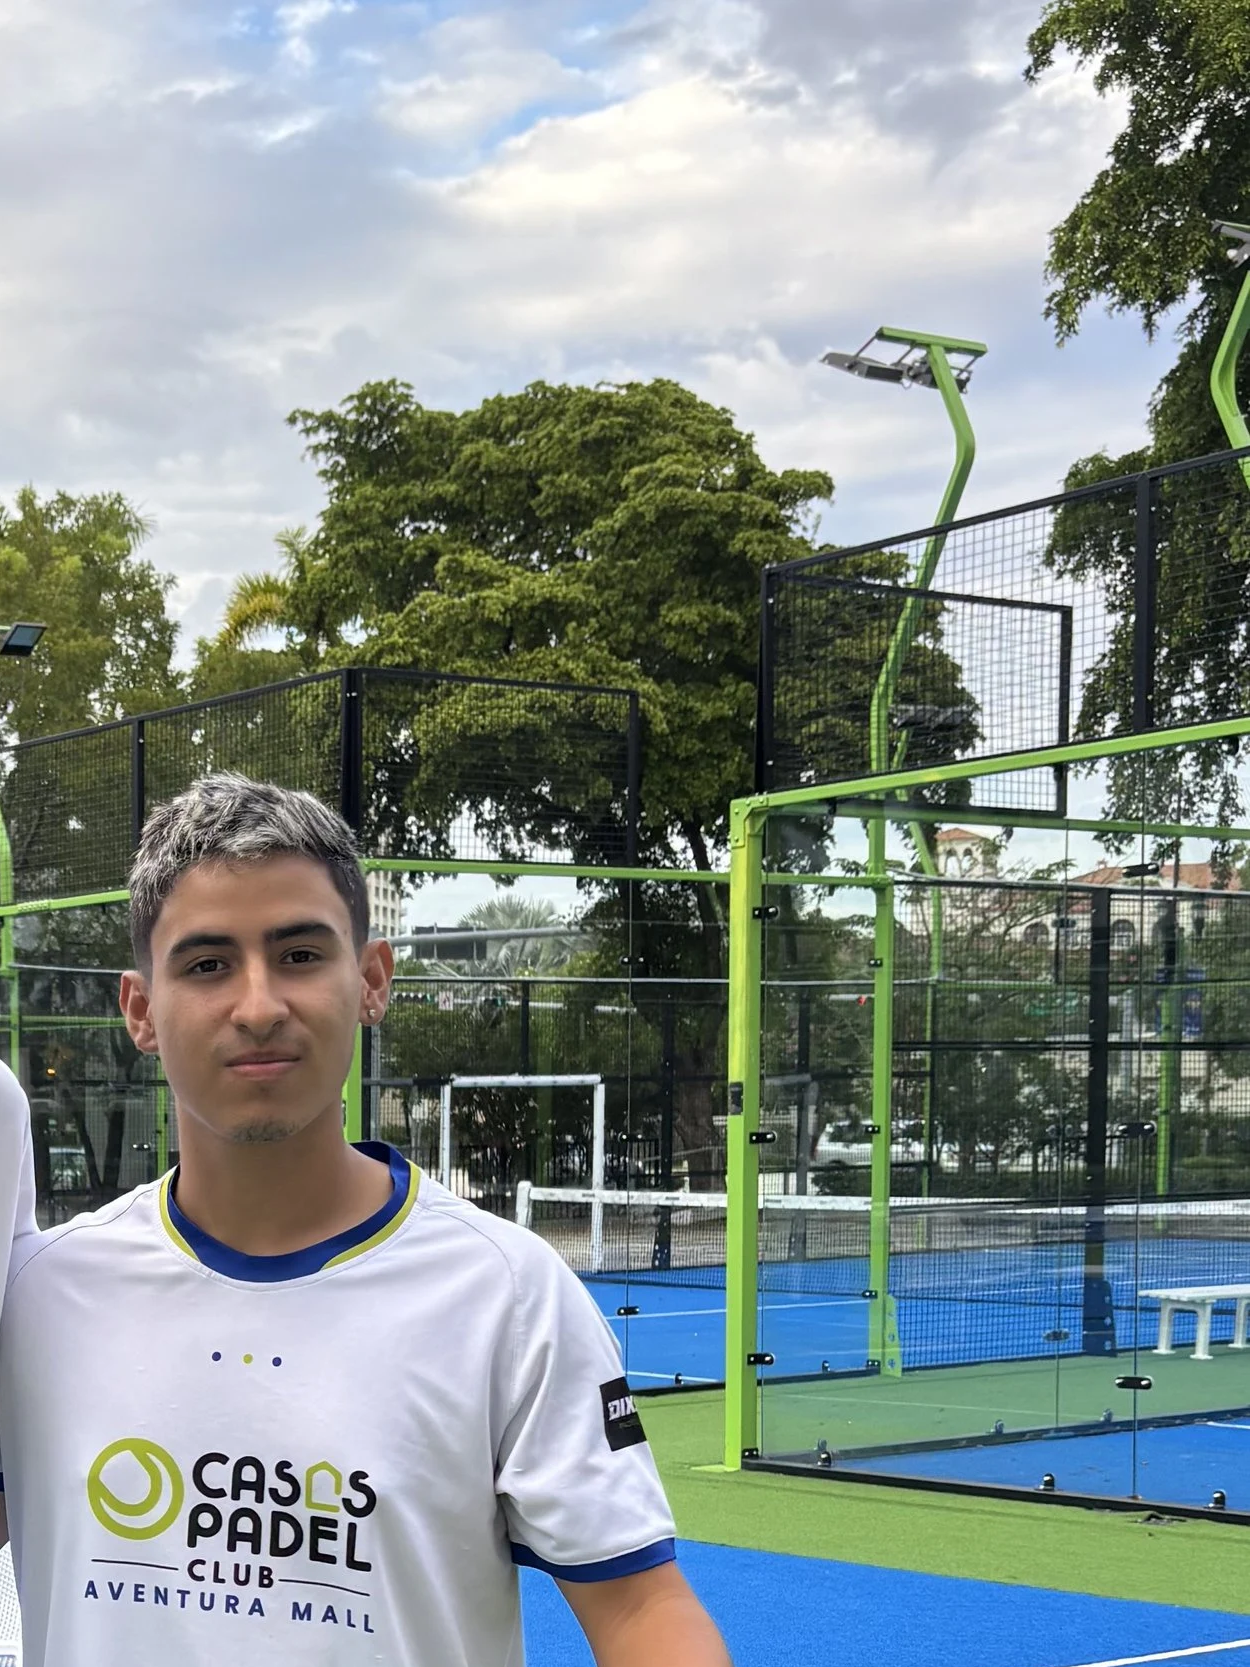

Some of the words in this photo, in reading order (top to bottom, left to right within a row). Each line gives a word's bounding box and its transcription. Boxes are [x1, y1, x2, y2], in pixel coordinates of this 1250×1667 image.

[187, 1502, 372, 1573] PADEL
[187, 1558, 275, 1589] CLUB
[84, 1579, 266, 1617] AVENTURA
[291, 1601, 375, 1634] MALL
